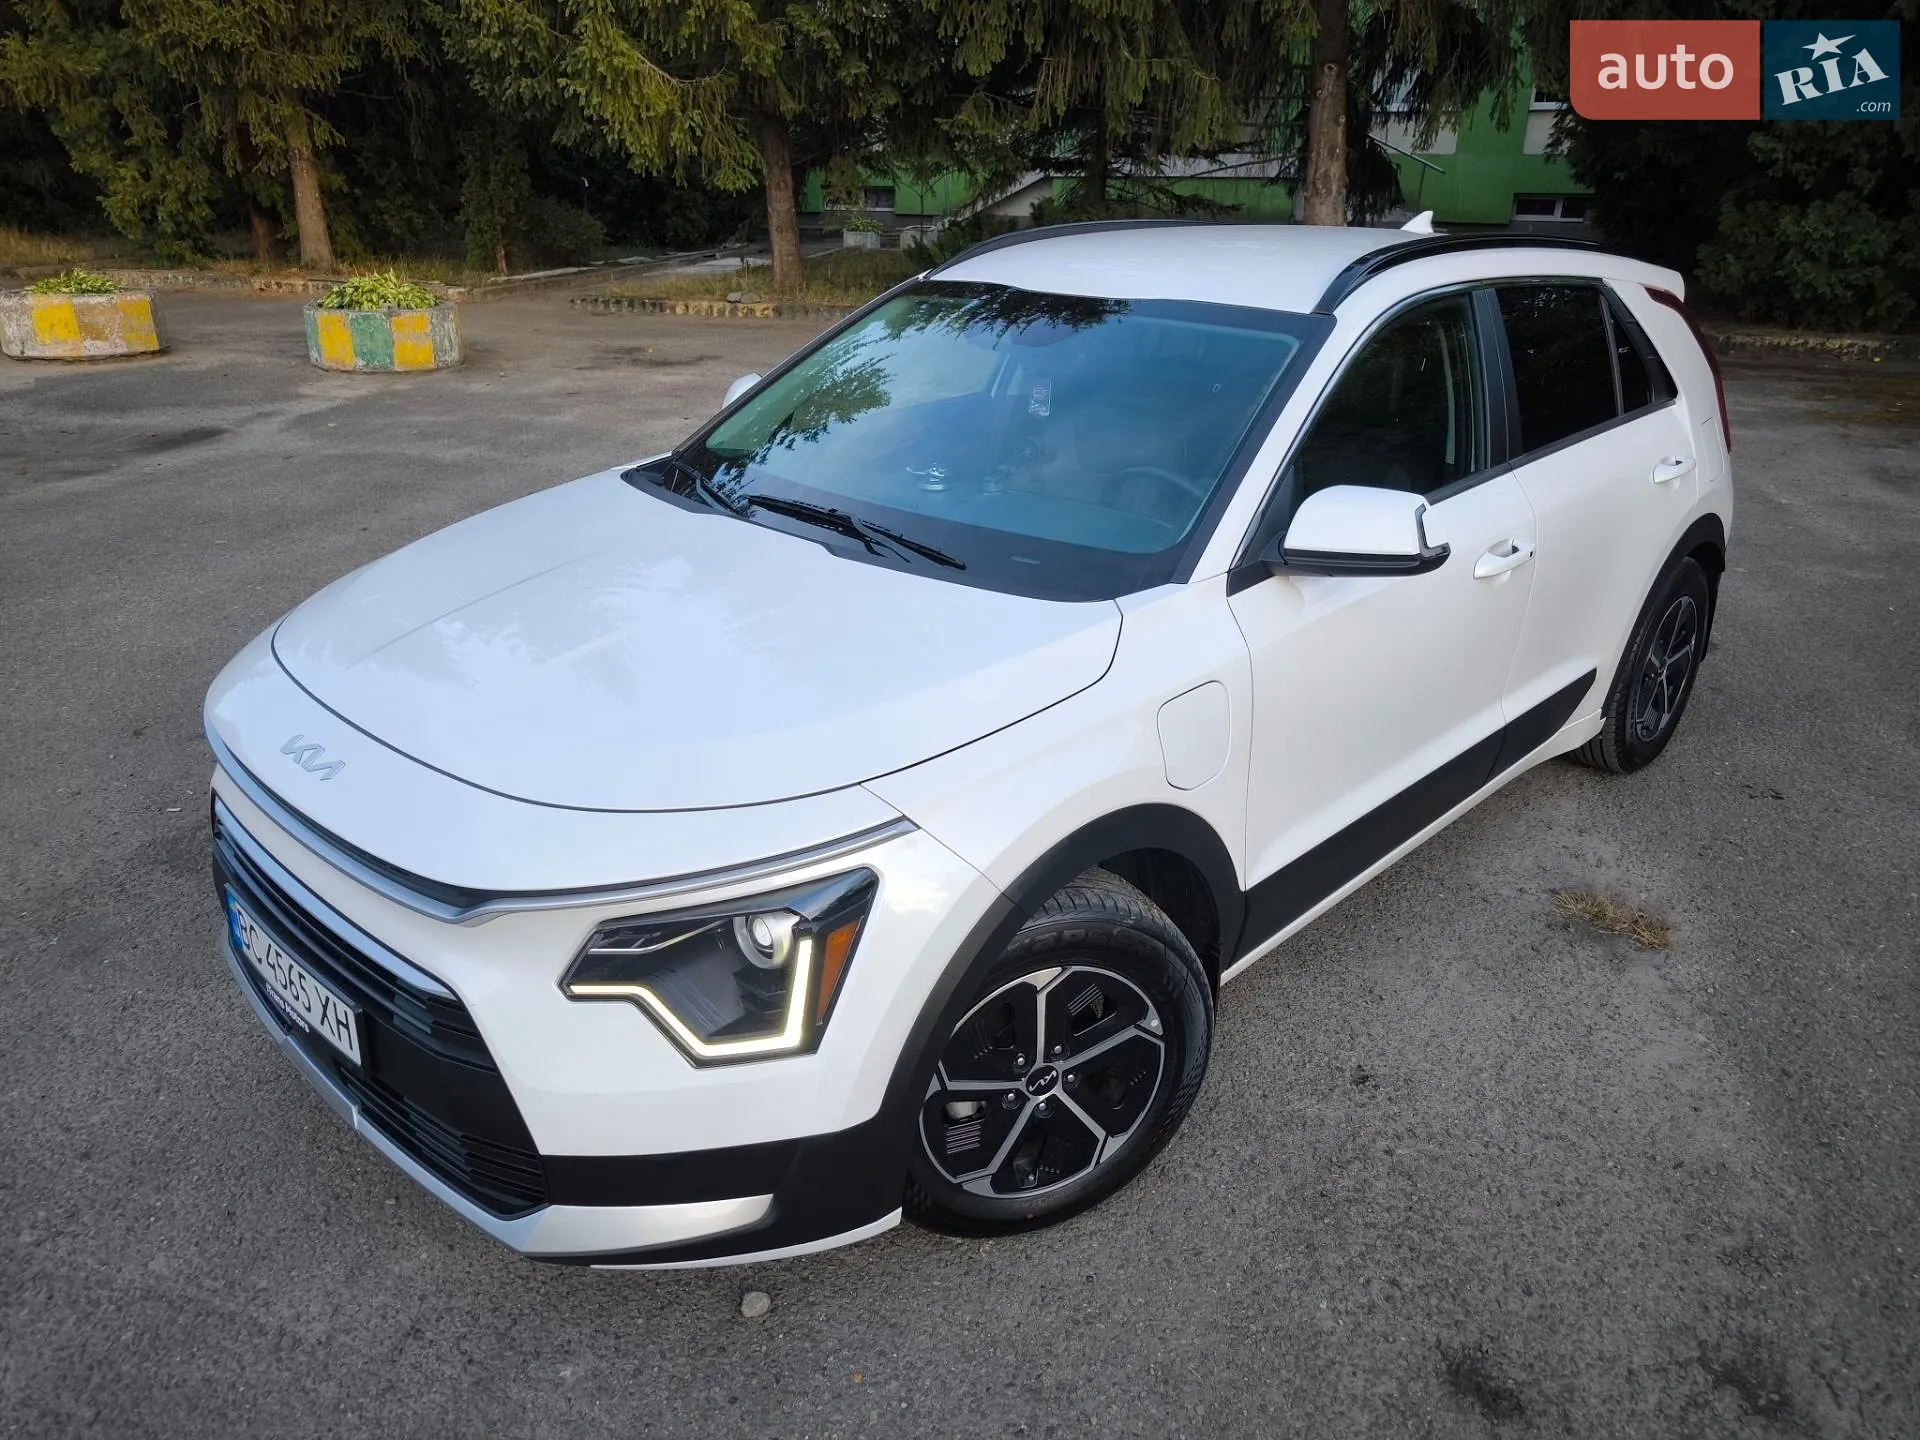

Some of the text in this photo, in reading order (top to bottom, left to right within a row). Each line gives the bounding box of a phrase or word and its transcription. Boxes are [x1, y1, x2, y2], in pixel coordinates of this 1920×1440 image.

[280, 734, 346, 781] KIA
[237, 909, 262, 965] BC
[266, 943, 311, 1013] 4565
[314, 985, 353, 1052] XH
